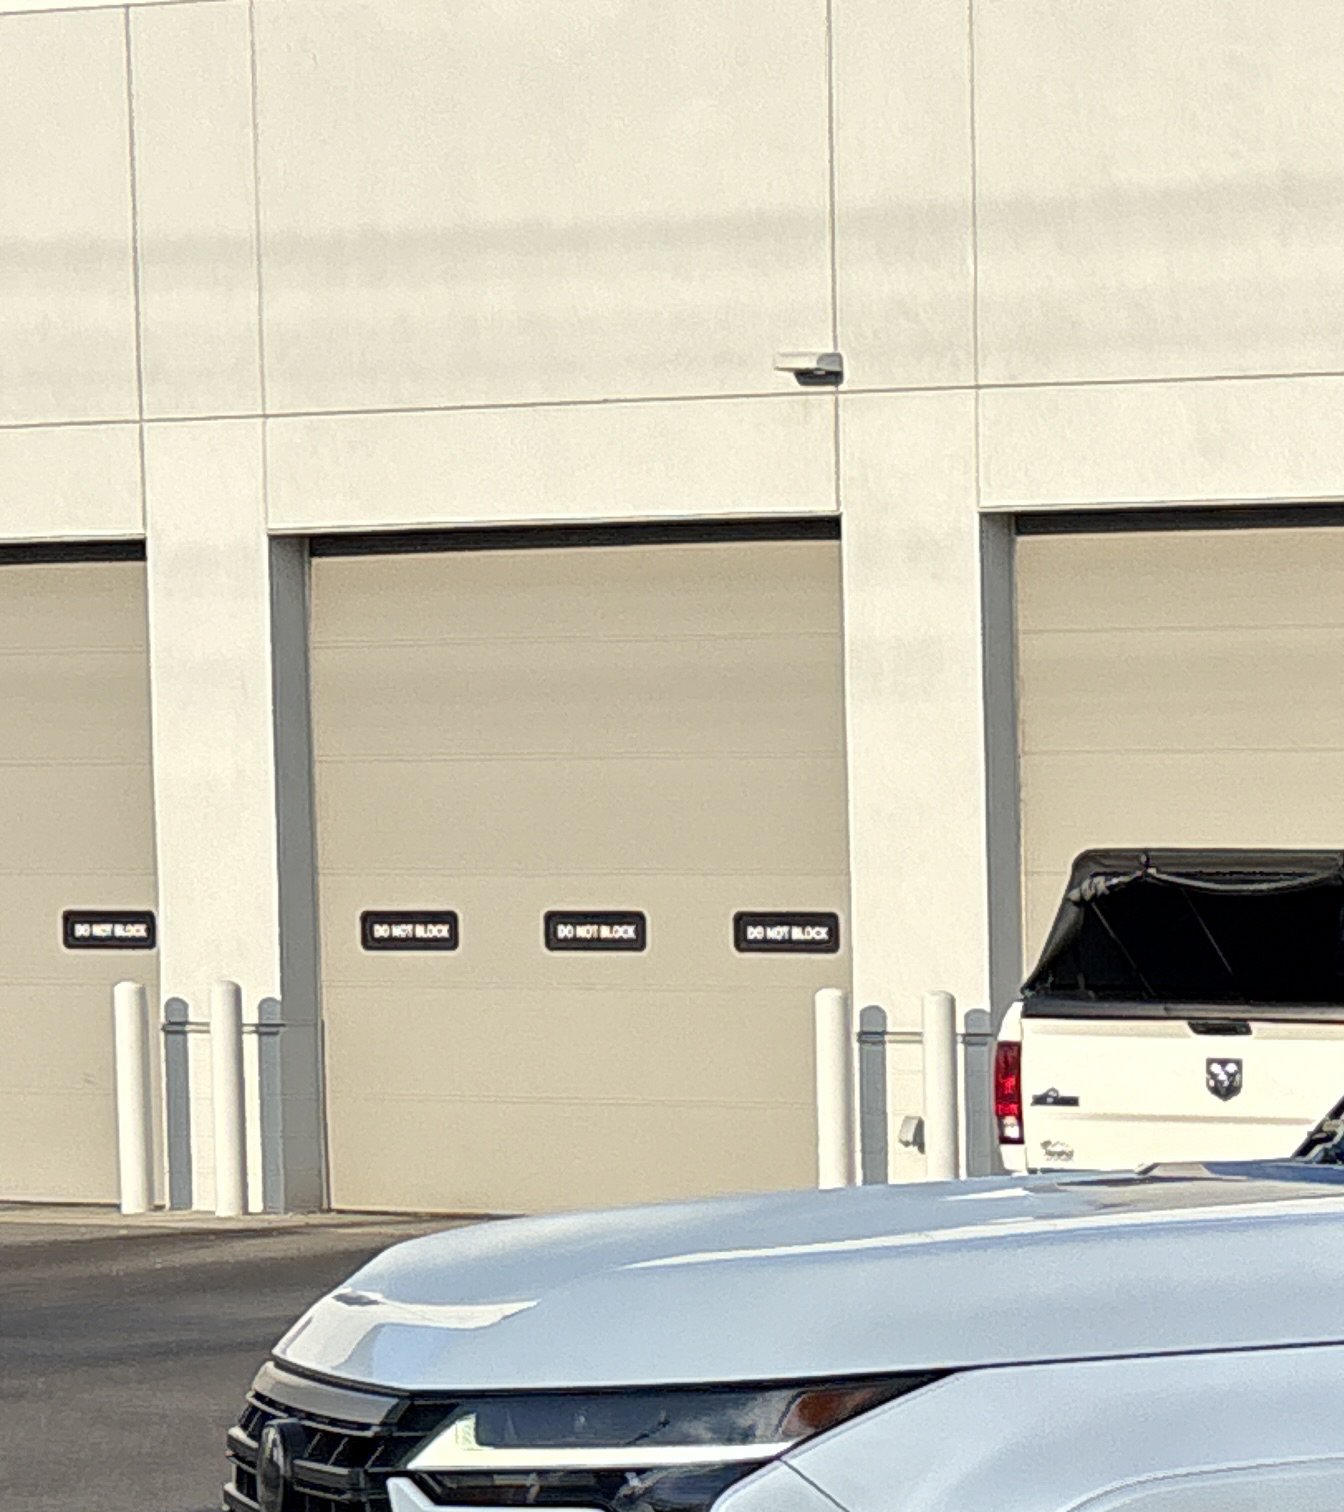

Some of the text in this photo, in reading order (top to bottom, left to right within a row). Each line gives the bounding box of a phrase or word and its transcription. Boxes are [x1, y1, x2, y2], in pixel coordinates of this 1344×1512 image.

[373, 923, 390, 938] DO
[415, 923, 450, 938] BLOCK
[557, 924, 637, 939] DO NOT BLOCK
[746, 925, 829, 941] DO NOT BLOCK
